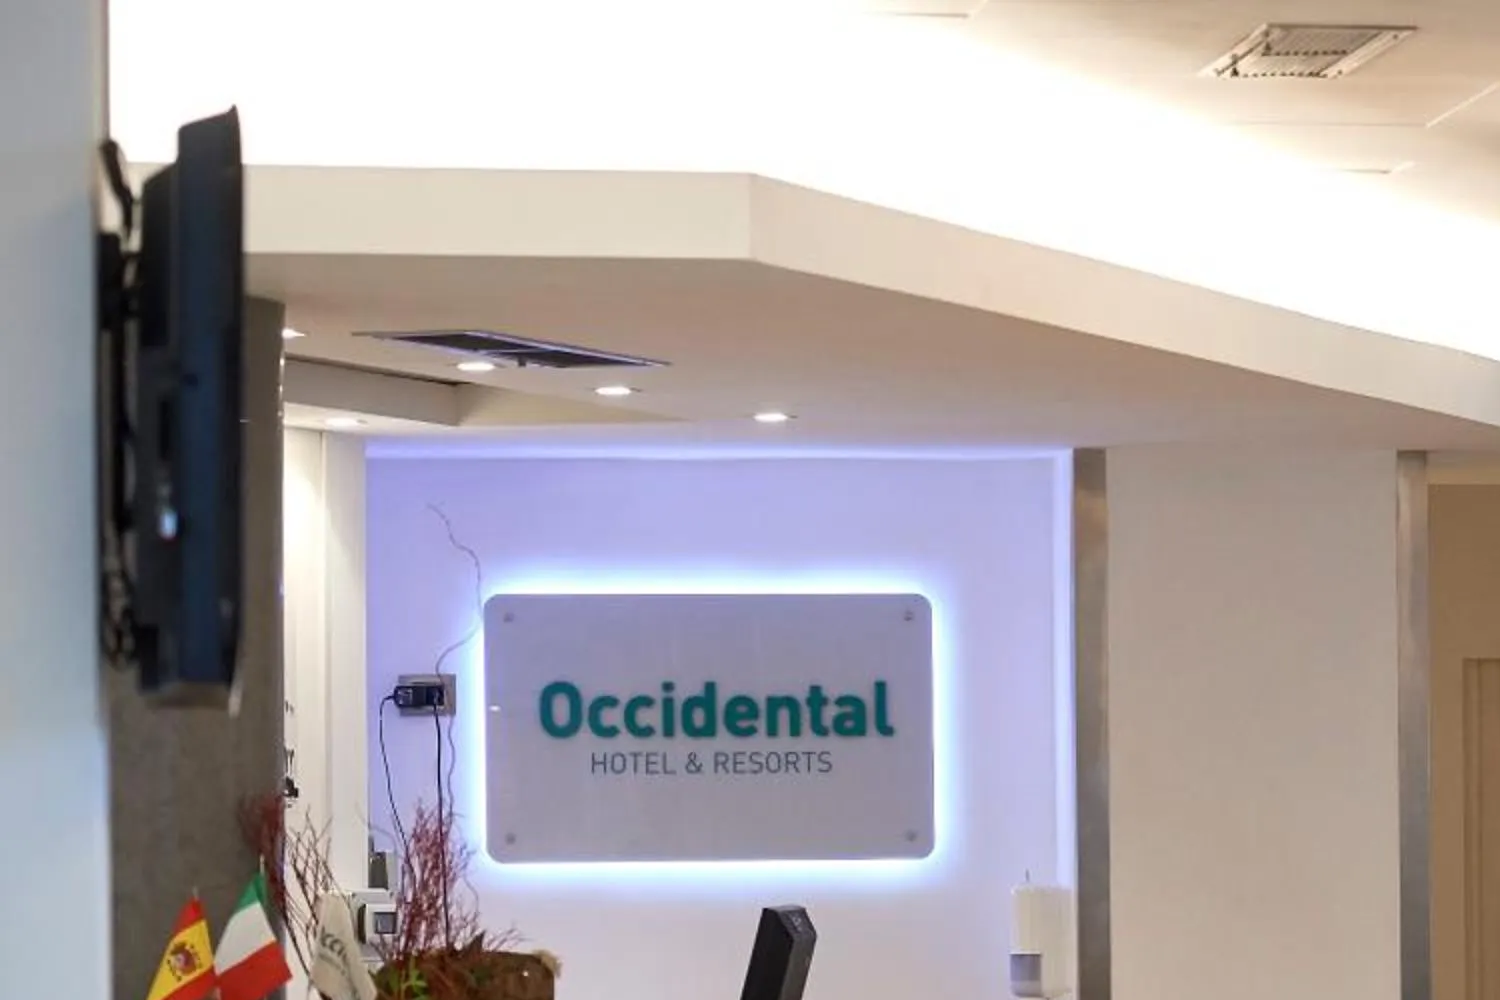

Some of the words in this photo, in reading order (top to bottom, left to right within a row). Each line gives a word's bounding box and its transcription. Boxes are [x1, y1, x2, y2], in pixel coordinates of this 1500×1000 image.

[538, 680, 895, 739] Occidental
[591, 751, 677, 775] HOTEL
[685, 751, 703, 775] &
[713, 751, 834, 775] RESORTS
